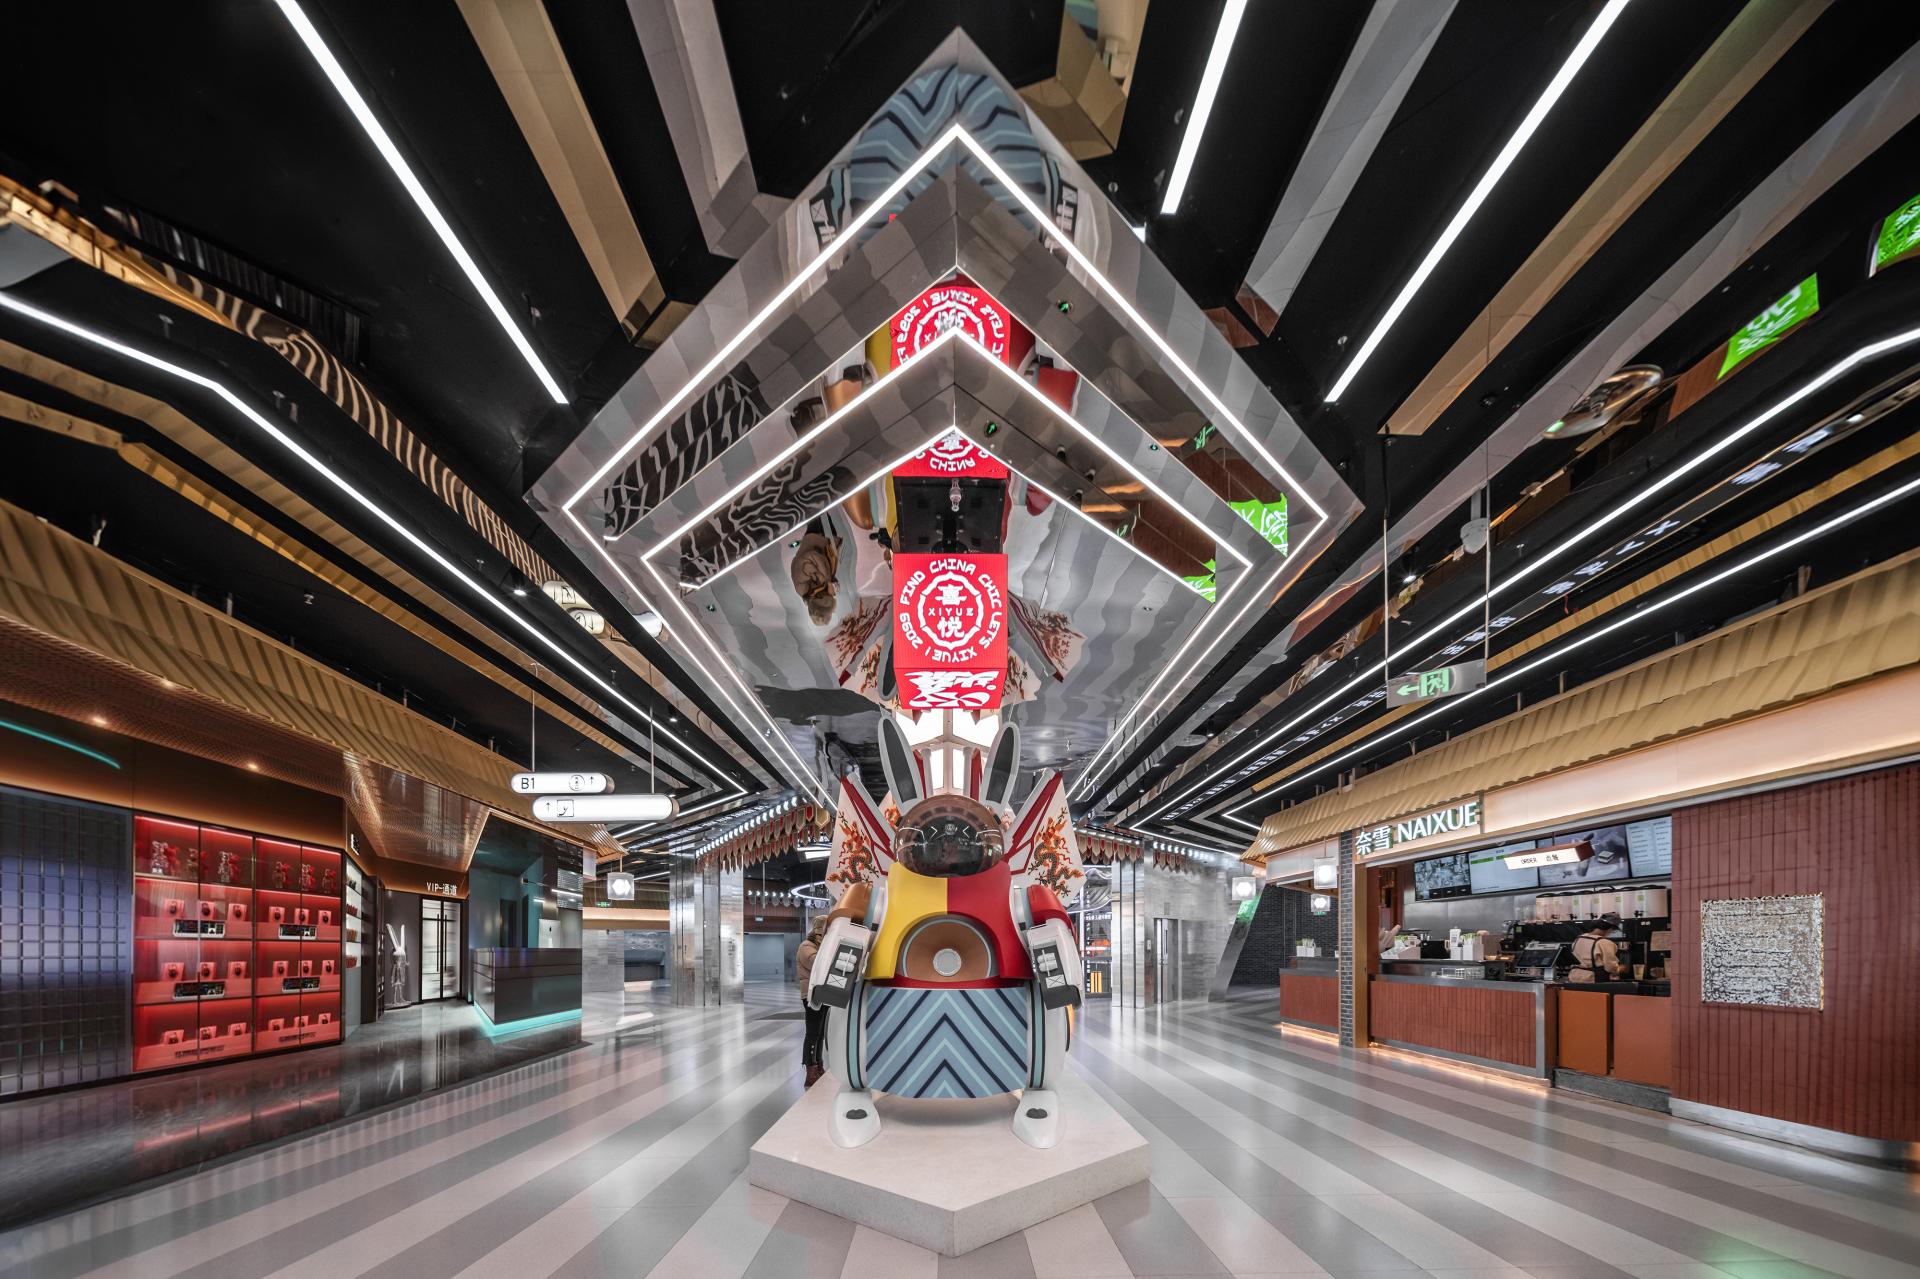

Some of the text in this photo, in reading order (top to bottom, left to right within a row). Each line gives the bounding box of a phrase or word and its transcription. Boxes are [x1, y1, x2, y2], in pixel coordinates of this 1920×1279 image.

[929, 558, 977, 575] CHINA
[900, 570, 926, 605] FIND
[978, 574, 1002, 609] CHIC
[928, 608, 975, 616] XIYUE
[899, 612, 924, 649] 2099
[937, 616, 965, 638] 悦
[978, 612, 1002, 649] LET'S
[932, 646, 978, 663] XIYUE
[521, 777, 535, 790] B1
[1355, 802, 1478, 855] 奈雪 NAIXUE
